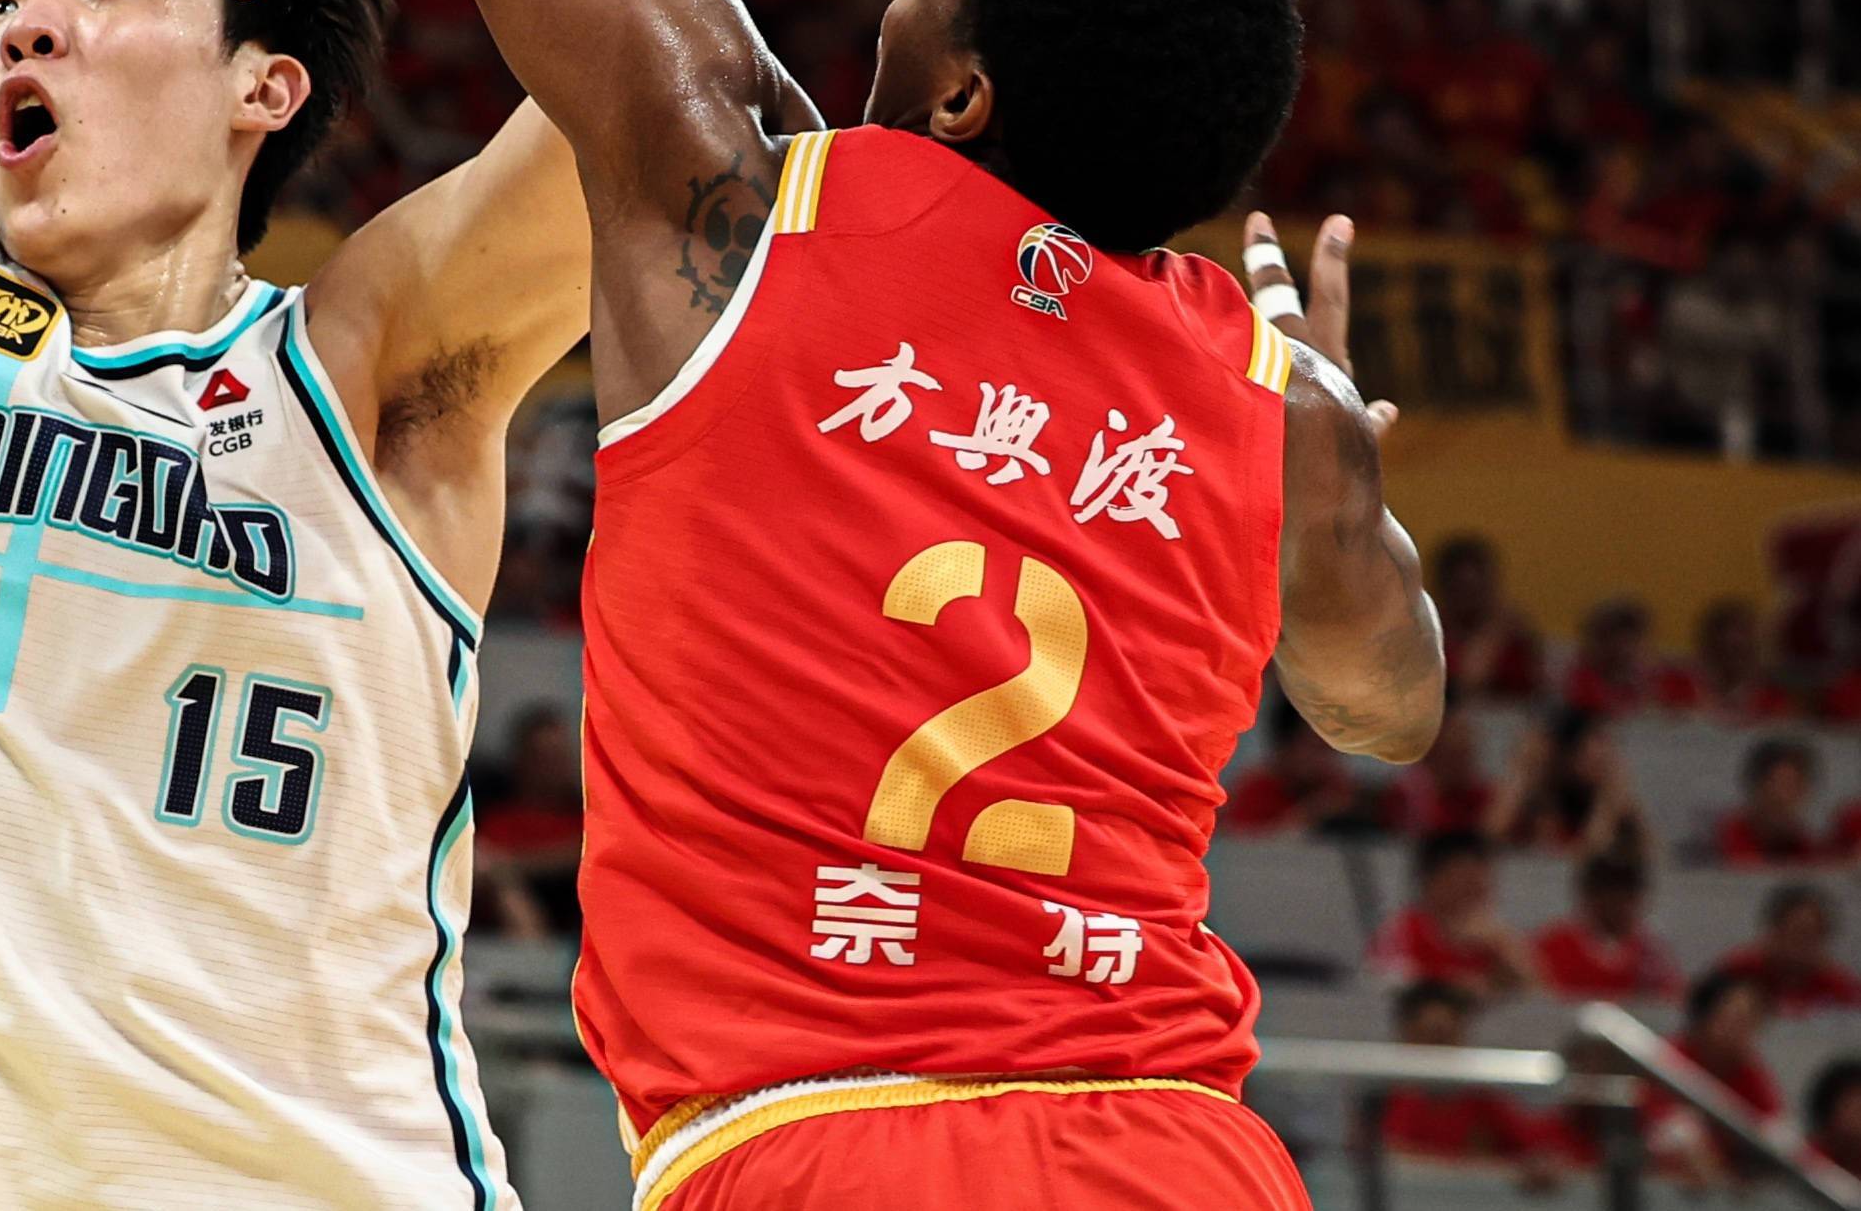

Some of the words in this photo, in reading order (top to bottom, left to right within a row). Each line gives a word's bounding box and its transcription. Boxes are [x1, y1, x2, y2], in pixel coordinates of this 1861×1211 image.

[1011, 284, 1068, 321] CBA
[208, 432, 253, 457] CGB
[154, 662, 334, 846] 15
[862, 540, 1088, 877] 2
